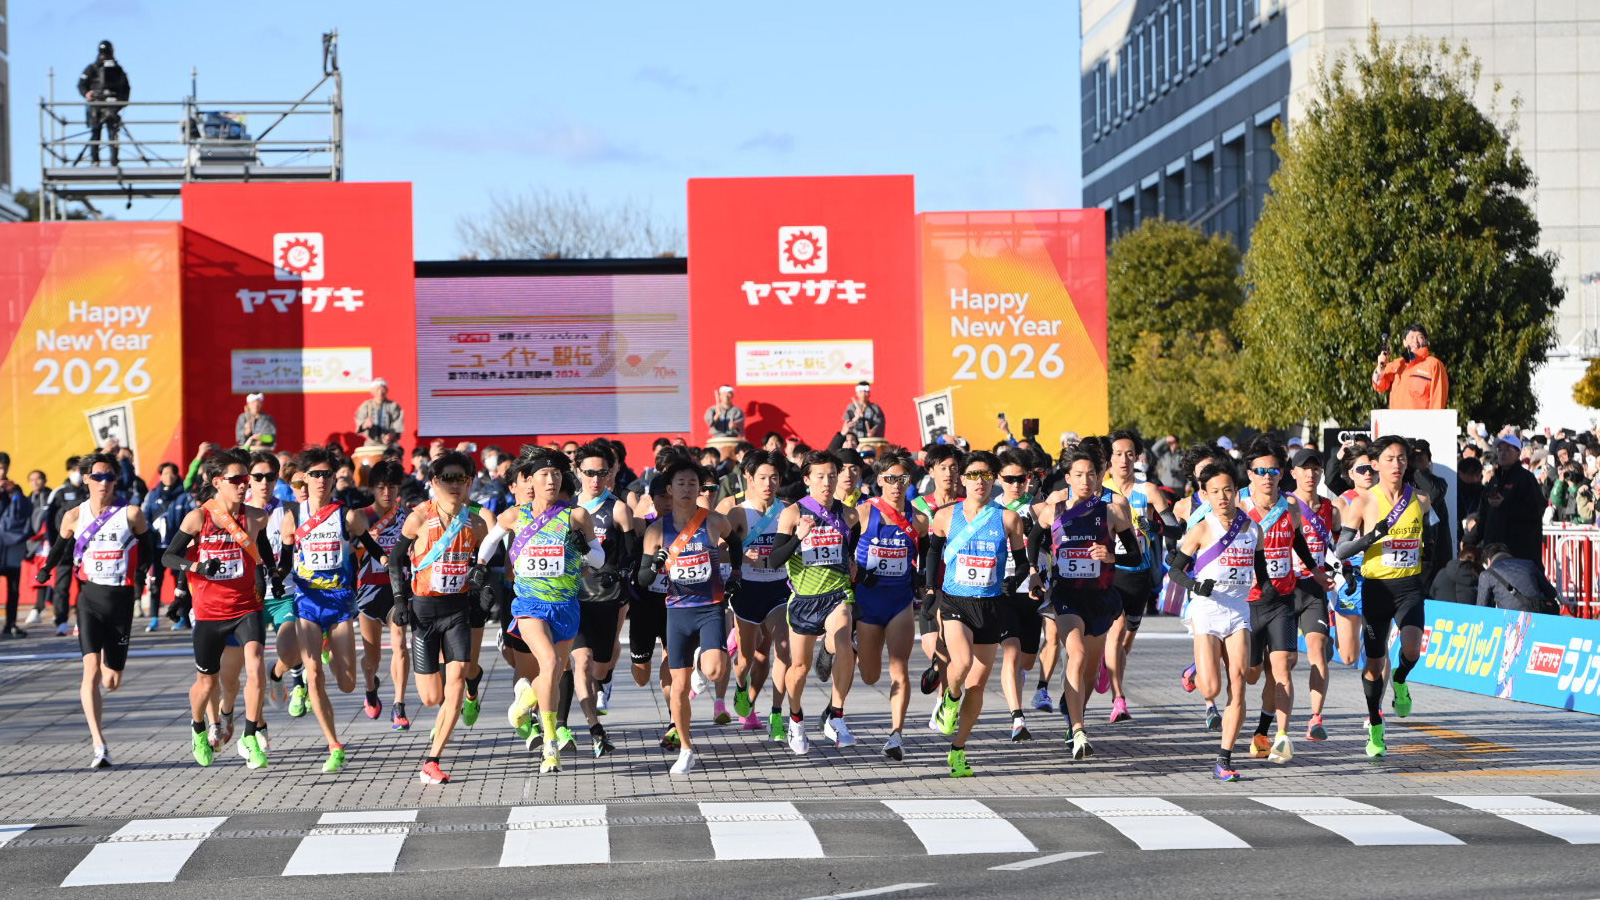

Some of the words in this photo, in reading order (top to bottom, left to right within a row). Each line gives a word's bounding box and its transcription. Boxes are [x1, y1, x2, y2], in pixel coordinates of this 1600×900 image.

[236, 287, 365, 313] ヤマザキ
[741, 279, 866, 306] ヤマザキ
[950, 288, 1030, 314] Happy
[68, 301, 151, 328] Happy
[951, 316, 1005, 338] New
[1006, 315, 1062, 337] Year
[36, 329, 93, 351] New
[95, 328, 152, 351] Year
[447, 346, 593, 368] ニューイヤー駅伝
[951, 343, 1065, 381] 2026
[33, 357, 152, 395] 2026
[311, 553, 338, 564] 21-1
[529, 548, 562, 556] ヤマザキ
[813, 547, 839, 559] 13-1
[95, 561, 120, 571] 8-1
[527, 557, 559, 570] 39-1
[677, 567, 707, 580] 25-1
[878, 559, 903, 571] 6-1
[1068, 560, 1095, 572] 5-1
[1229, 568, 1252, 580] 2-1
[1425, 618, 1503, 677] ランチパック
[1537, 650, 1561, 669] ヤマザキ
